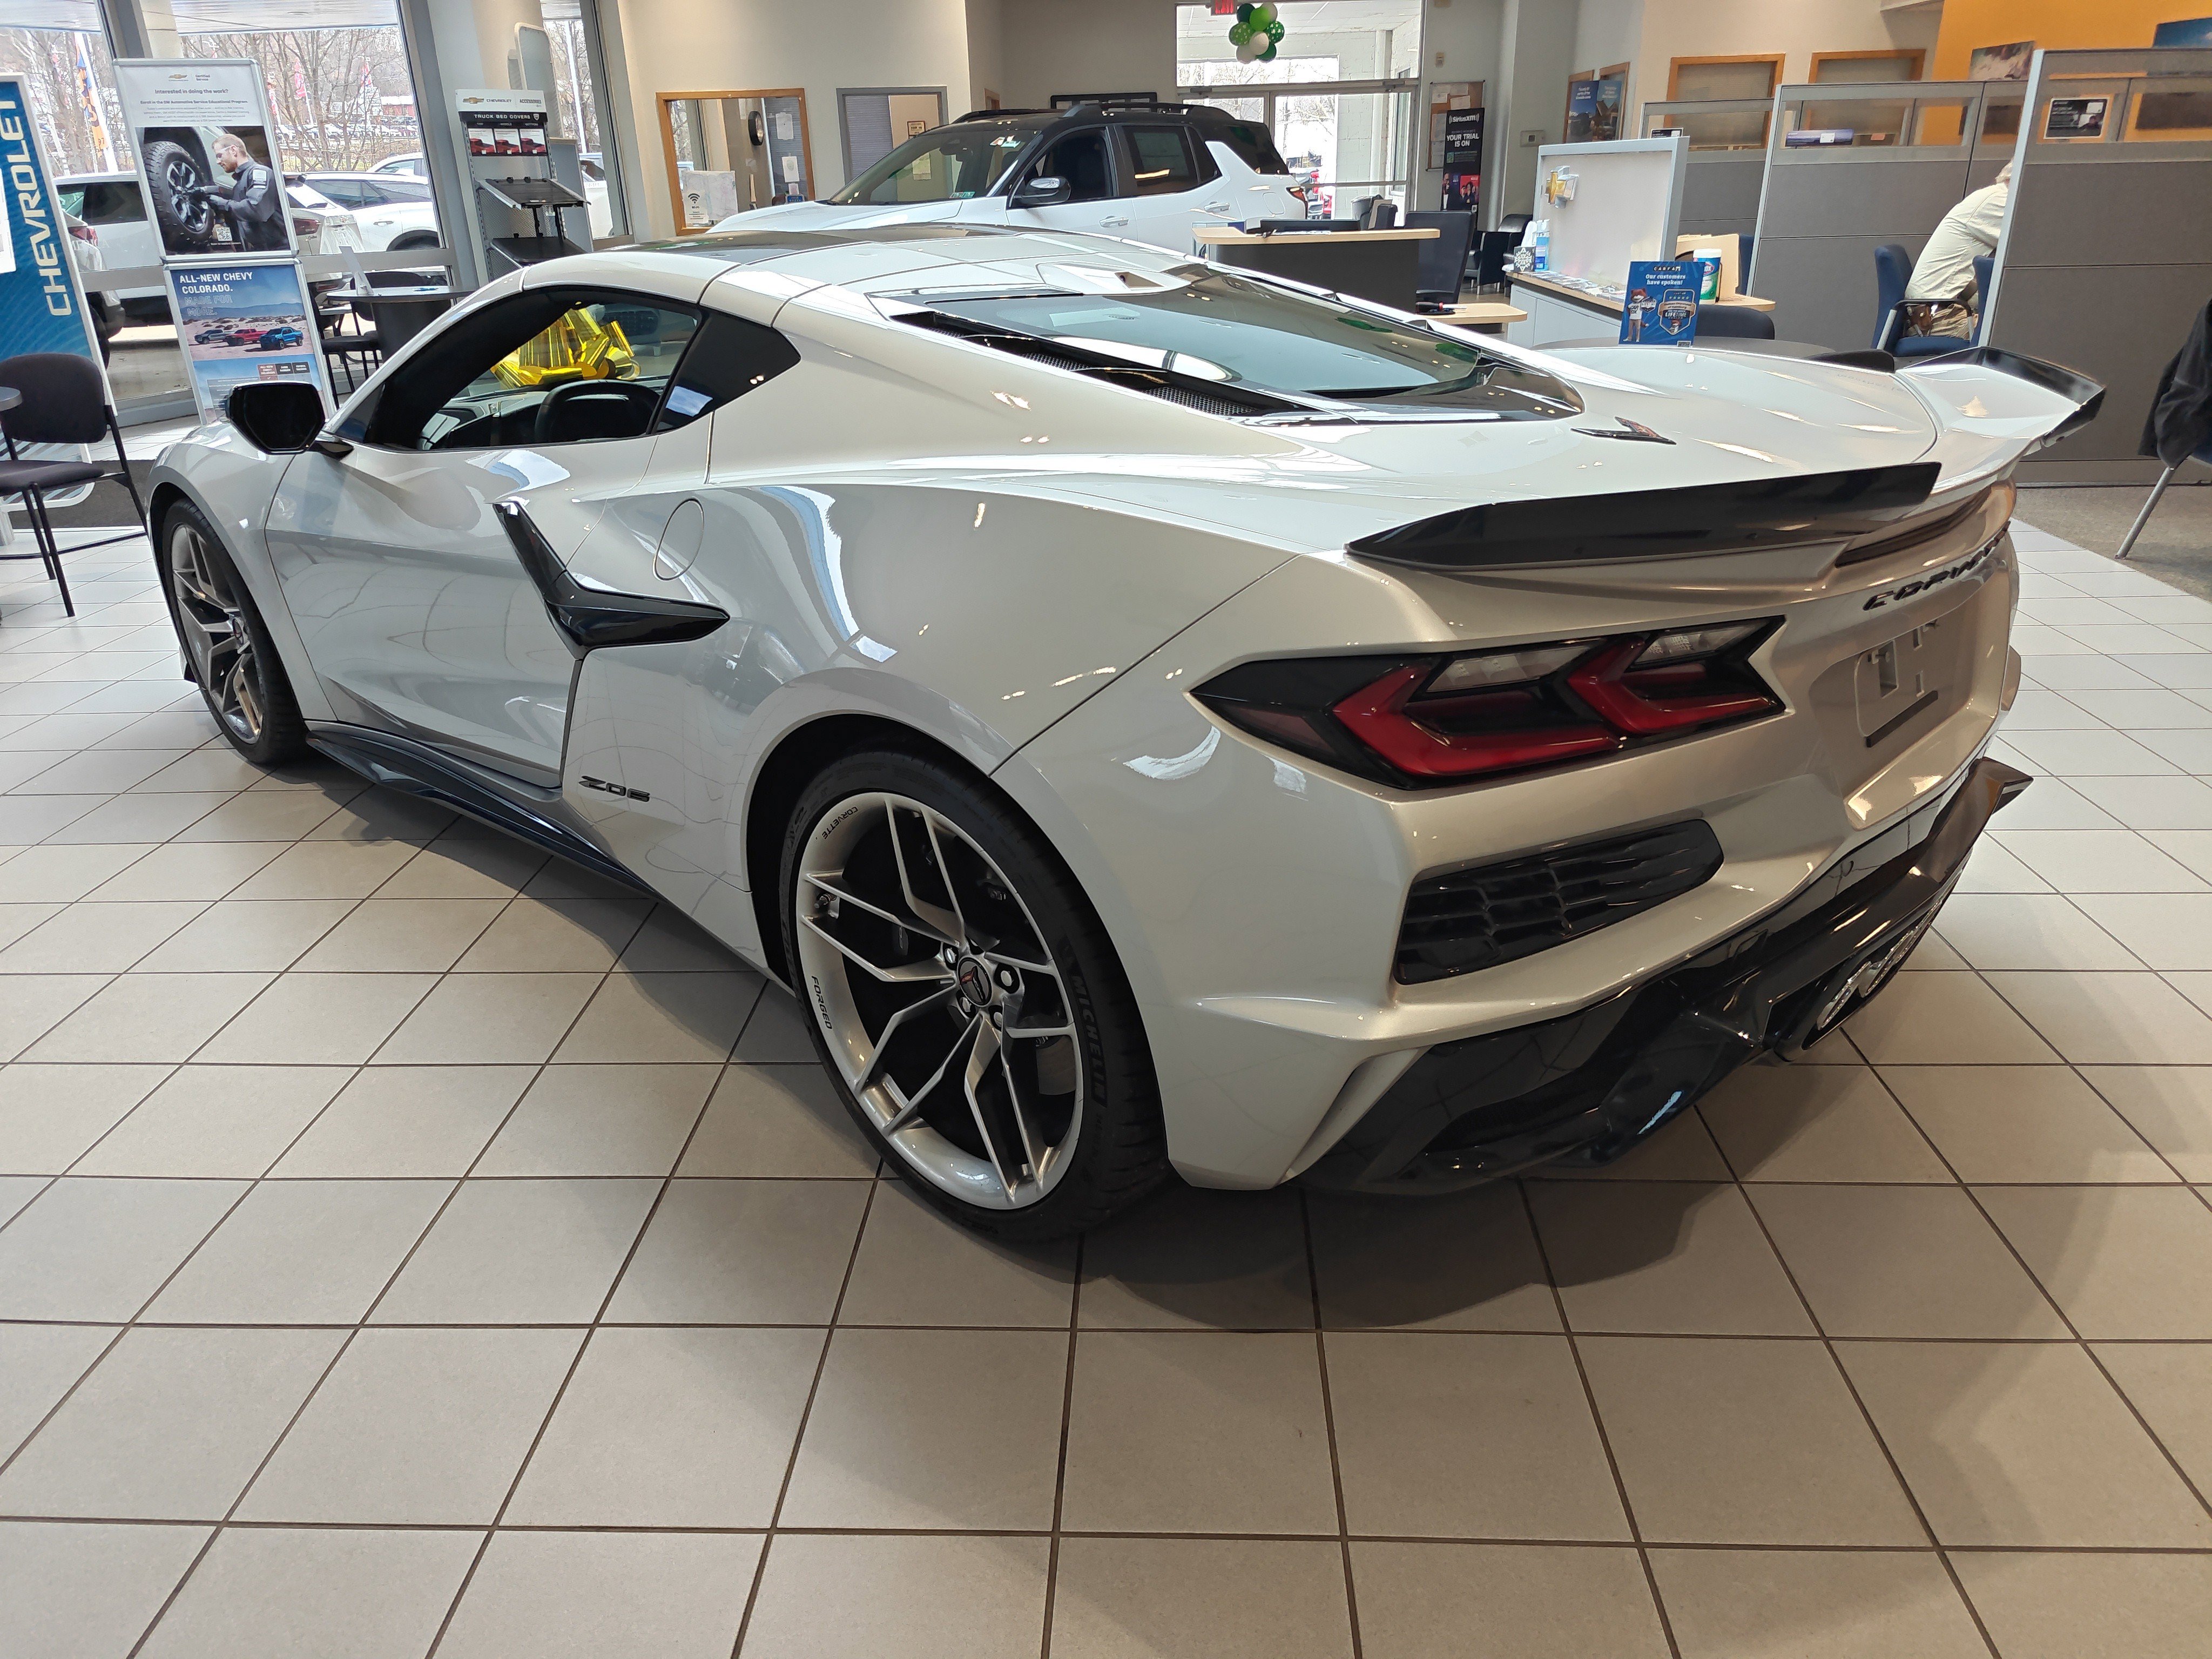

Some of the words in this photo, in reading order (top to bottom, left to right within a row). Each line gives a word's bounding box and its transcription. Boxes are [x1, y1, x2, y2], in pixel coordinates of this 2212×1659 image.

[180, 273, 221, 283] ALL-NEW
[223, 272, 253, 281] CHEVY
[182, 284, 233, 294] COLORADO.
[184, 295, 212, 305] MADE
[213, 294, 233, 304] FOR
[187, 307, 218, 316] MORE.
[578, 775, 650, 802] Z06
[821, 806, 858, 840] CORVETTE
[811, 975, 832, 1029] FORGED
[1071, 974, 1107, 1100] MICHELIN
